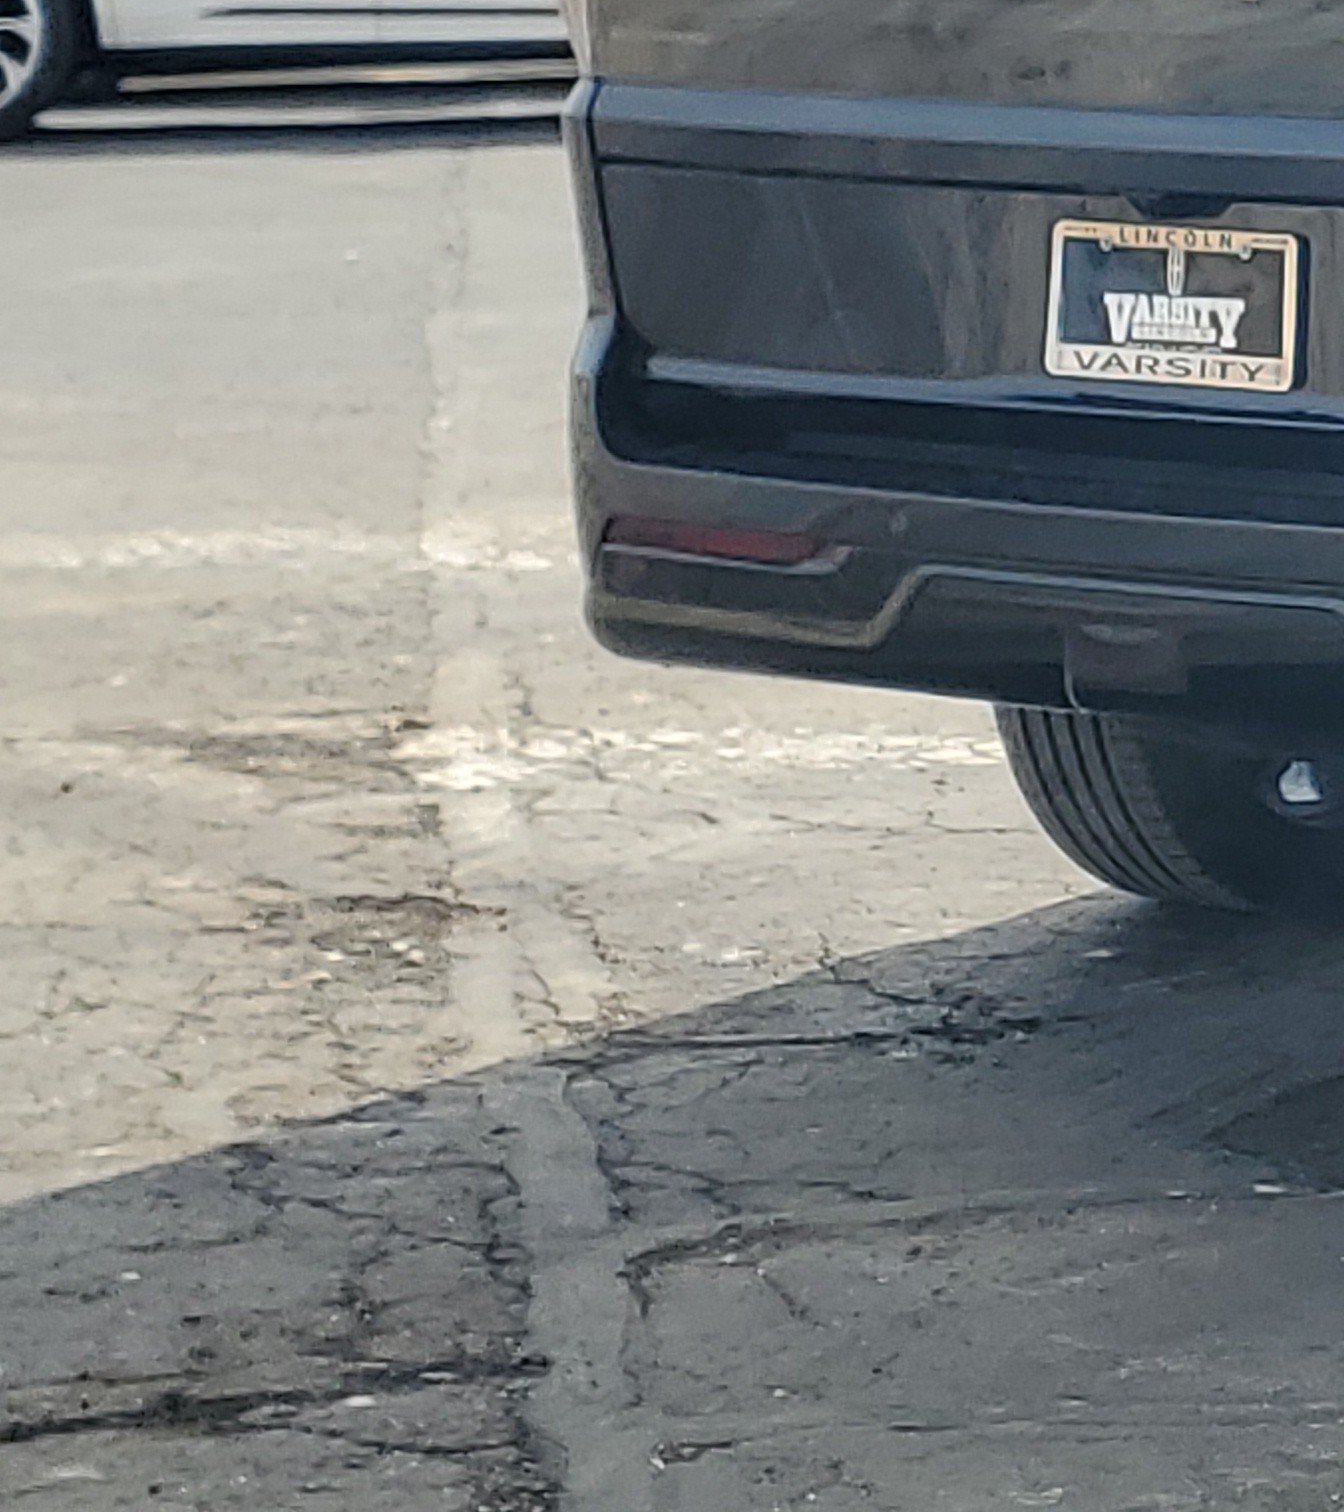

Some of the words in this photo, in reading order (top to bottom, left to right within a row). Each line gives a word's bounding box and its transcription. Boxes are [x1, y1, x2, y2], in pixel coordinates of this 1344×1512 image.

[1118, 227, 1234, 250] LINCOLN
[1103, 290, 1246, 349] VARSITY
[1073, 350, 1266, 384] VARSITY
